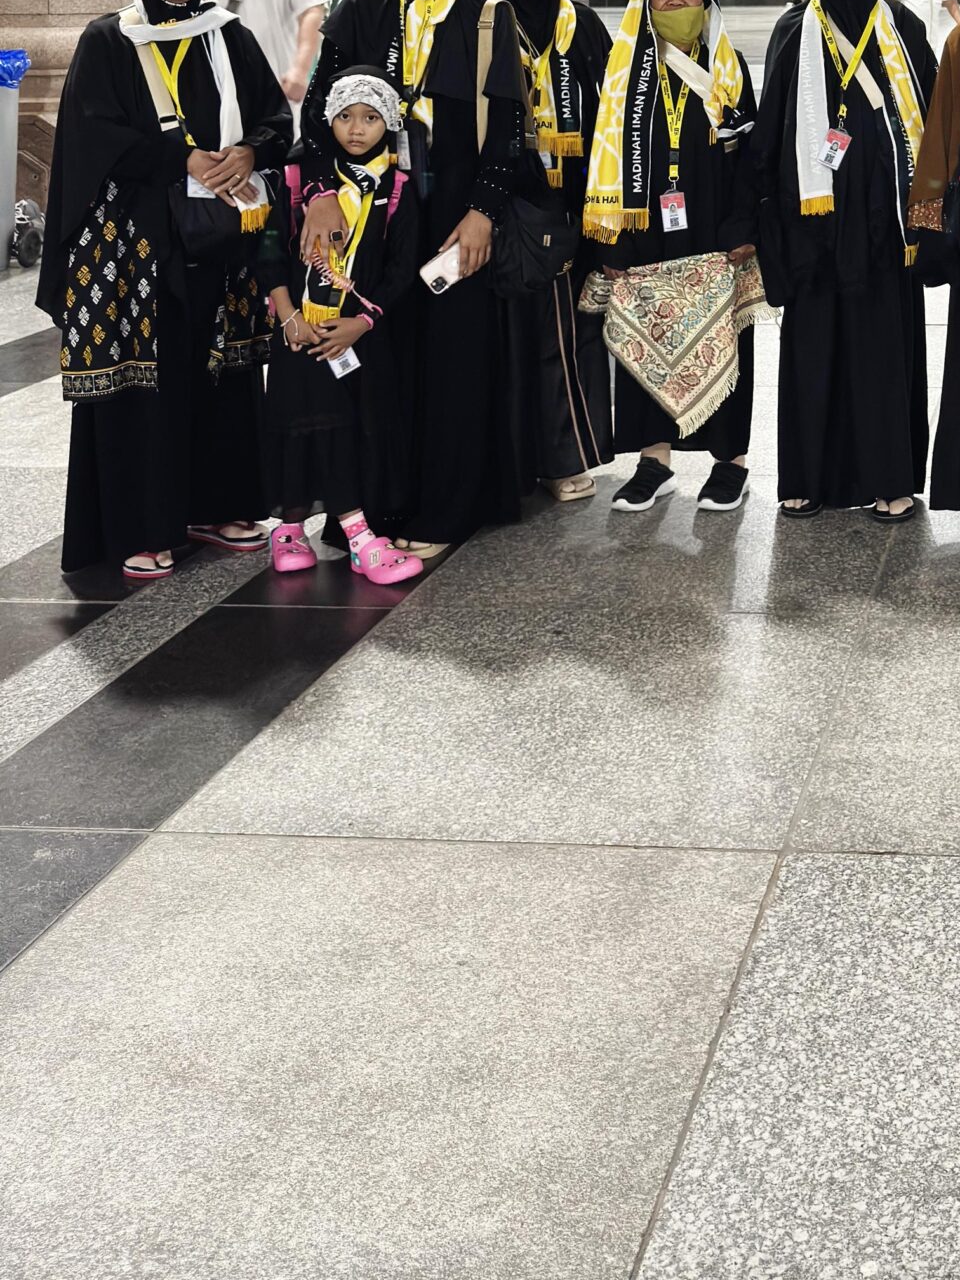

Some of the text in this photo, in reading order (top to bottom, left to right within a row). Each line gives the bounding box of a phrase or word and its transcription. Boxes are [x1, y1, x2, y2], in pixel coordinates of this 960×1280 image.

[560, 59, 572, 118] MADINAH
[636, 47, 654, 94] WISATA
[632, 95, 645, 128] IMAN
[632, 131, 643, 193] MADINAH
